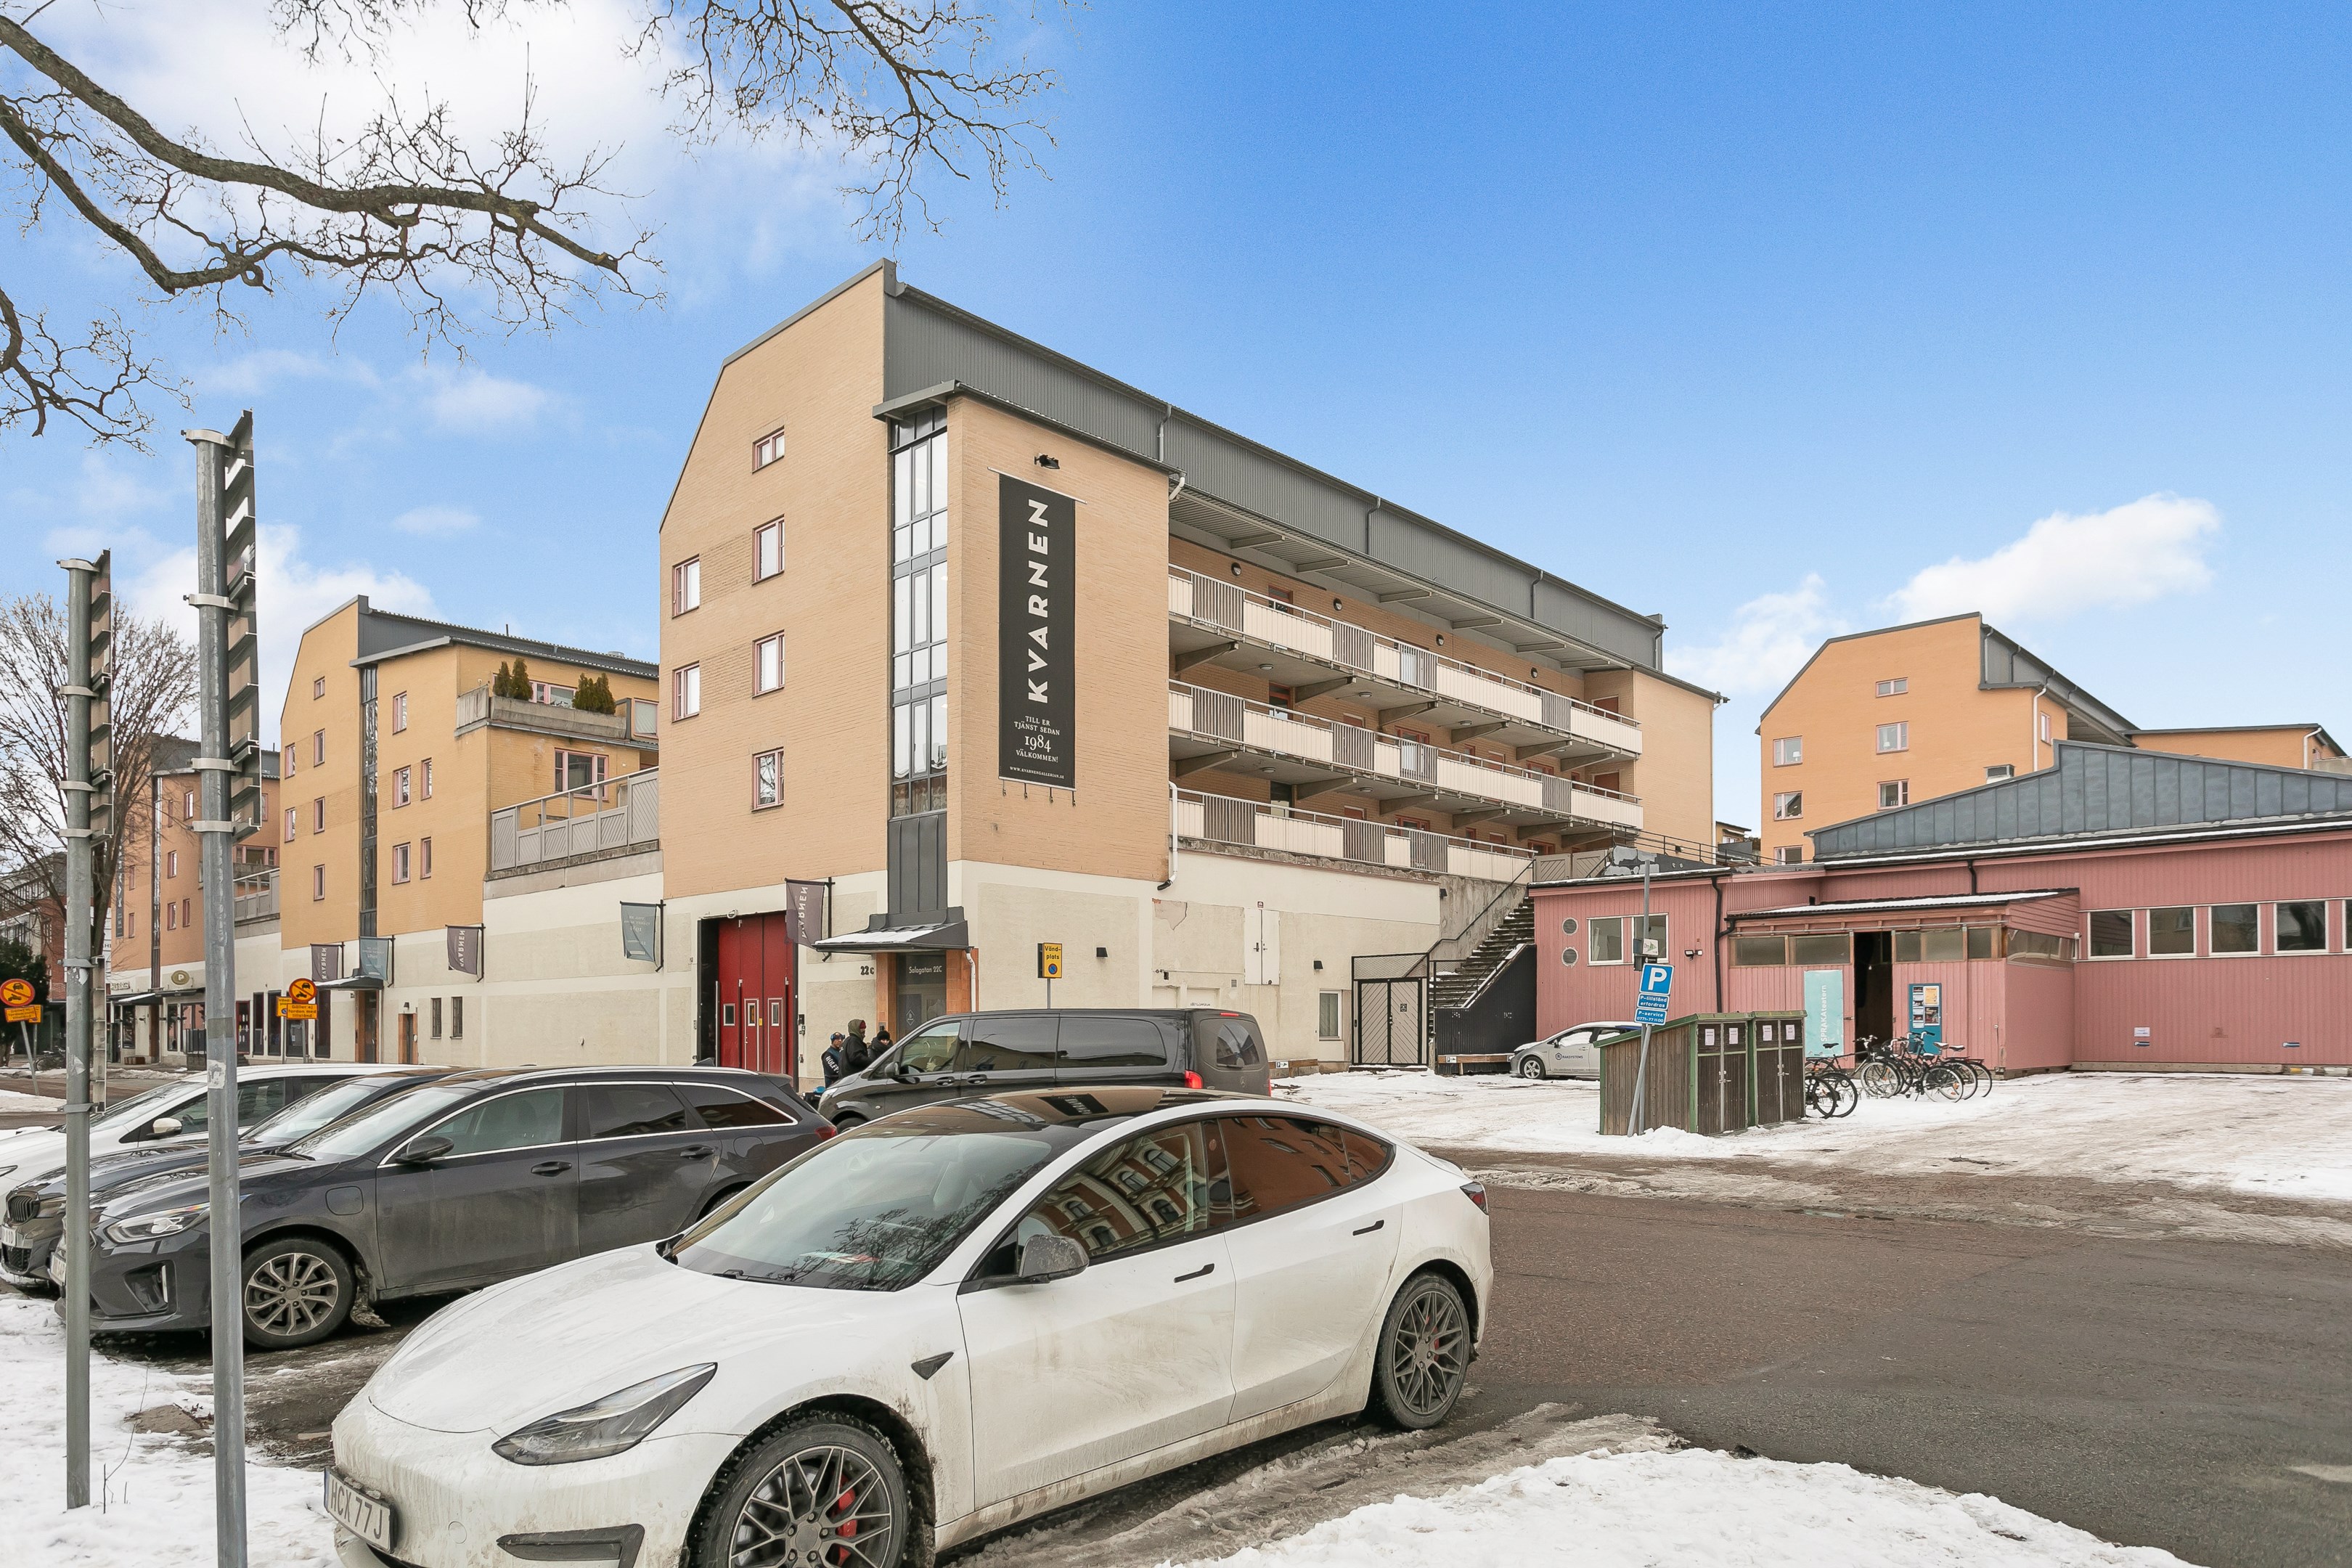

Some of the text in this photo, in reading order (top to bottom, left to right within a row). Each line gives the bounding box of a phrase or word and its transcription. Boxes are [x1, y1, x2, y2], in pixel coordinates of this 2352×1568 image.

[1028, 498, 1048, 703] KVARNEN
[1014, 721, 1060, 735] TJÄNST SEDAN
[1024, 735, 1051, 753] 1984
[1016, 748, 1058, 763] VÄLKOMMEN!
[1648, 967, 1667, 991] P
[330, 1479, 383, 1540] HCX 77J
